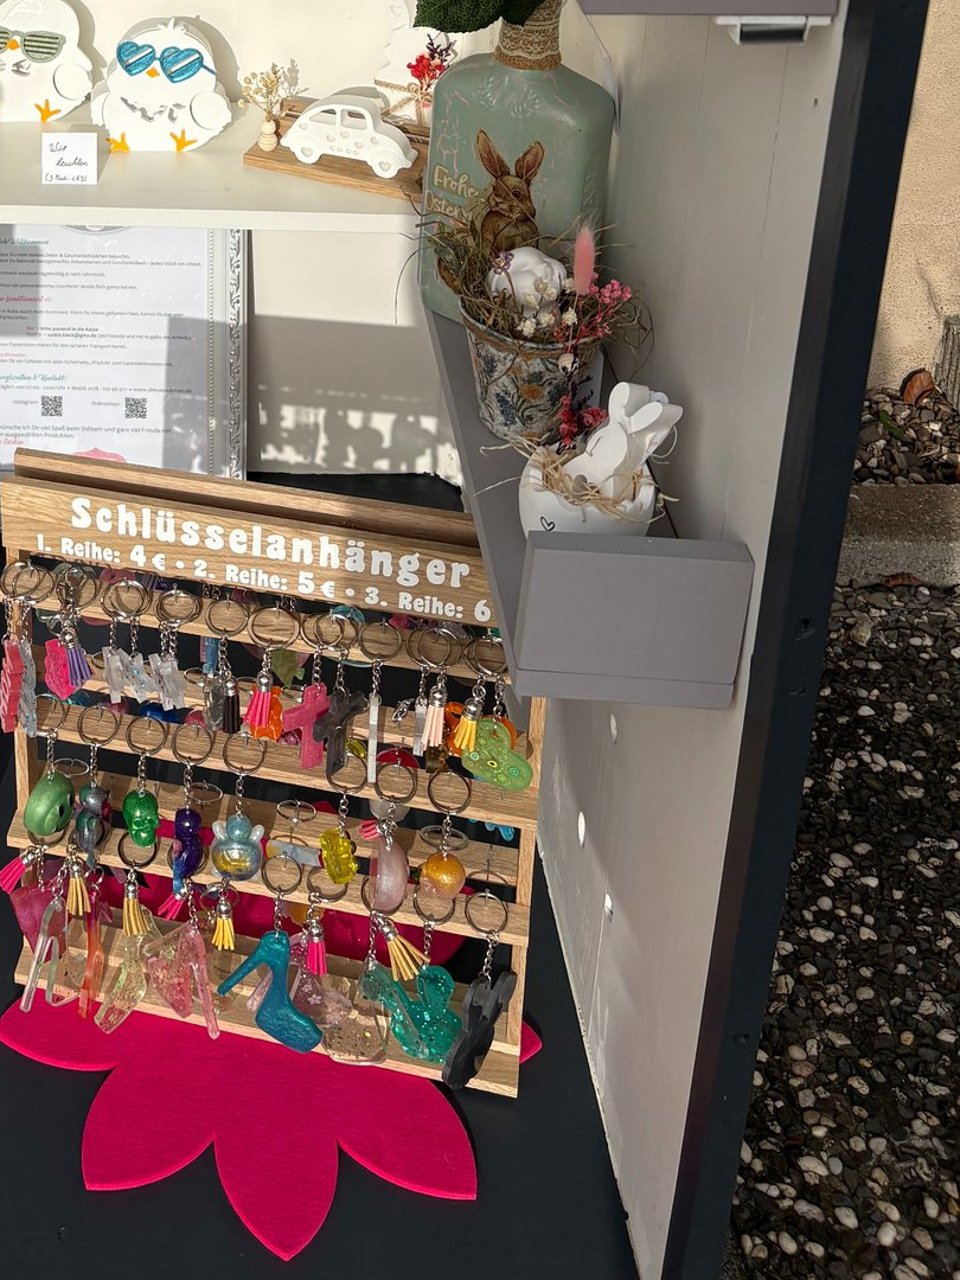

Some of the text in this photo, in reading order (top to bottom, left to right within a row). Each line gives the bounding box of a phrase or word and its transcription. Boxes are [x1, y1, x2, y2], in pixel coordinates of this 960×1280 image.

[434, 164, 479, 198] Frohe
[36, 533, 52, 552] 1.
[60, 536, 121, 564] Reihe:
[194, 558, 216, 579] 2.
[225, 564, 288, 591] Reihe:
[364, 586, 388, 607] 3.
[397, 592, 464, 619] Reihe:
[71, 498, 471, 588] Schlüsselanhänger
